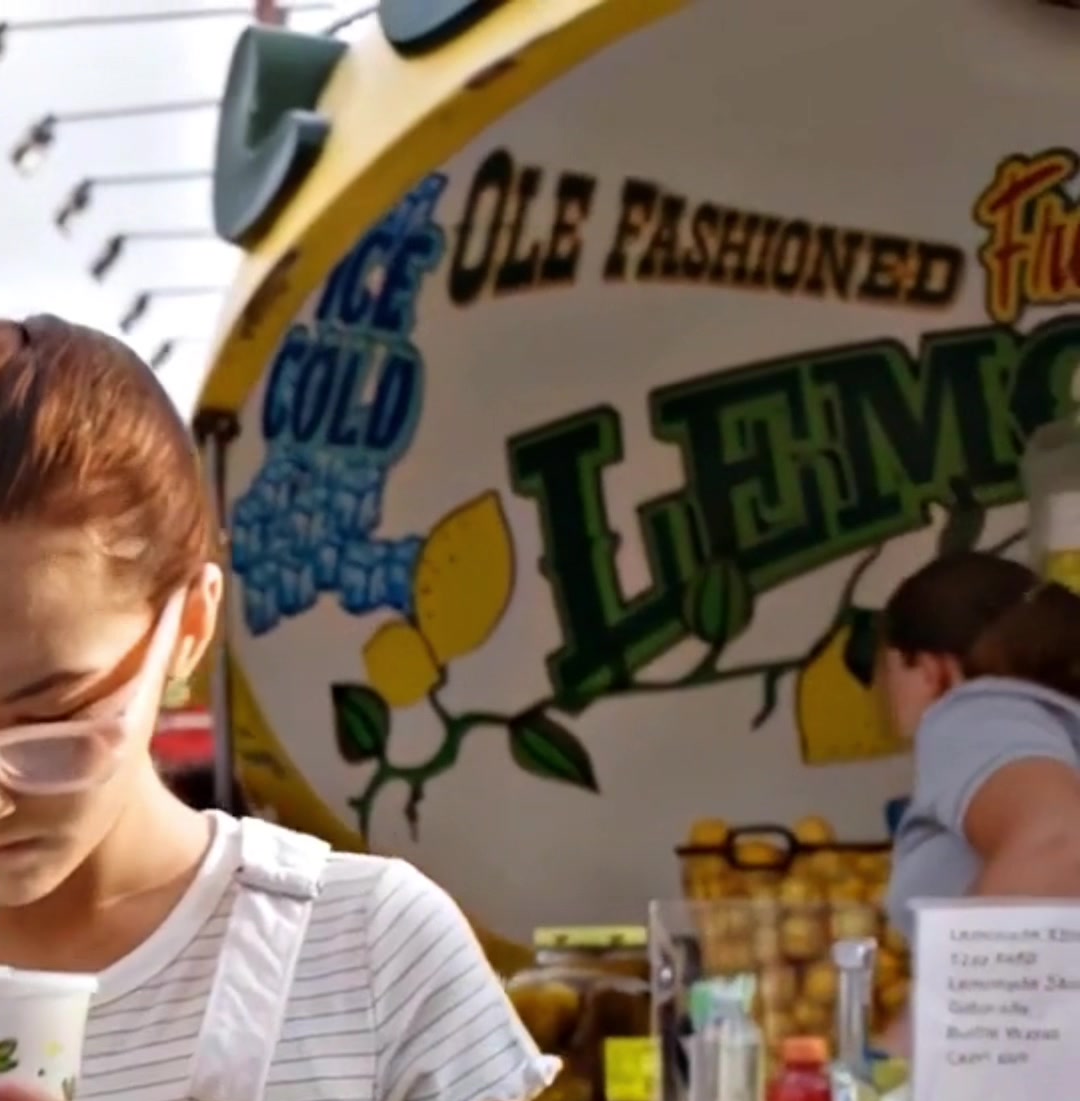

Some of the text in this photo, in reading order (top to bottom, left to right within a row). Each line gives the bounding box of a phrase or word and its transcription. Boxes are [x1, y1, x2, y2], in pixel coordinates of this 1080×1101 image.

[313, 224, 444, 333] ICE
[450, 148, 597, 308] OLE
[602, 176, 966, 310] FASHIONED
[261, 338, 421, 449] COLD
